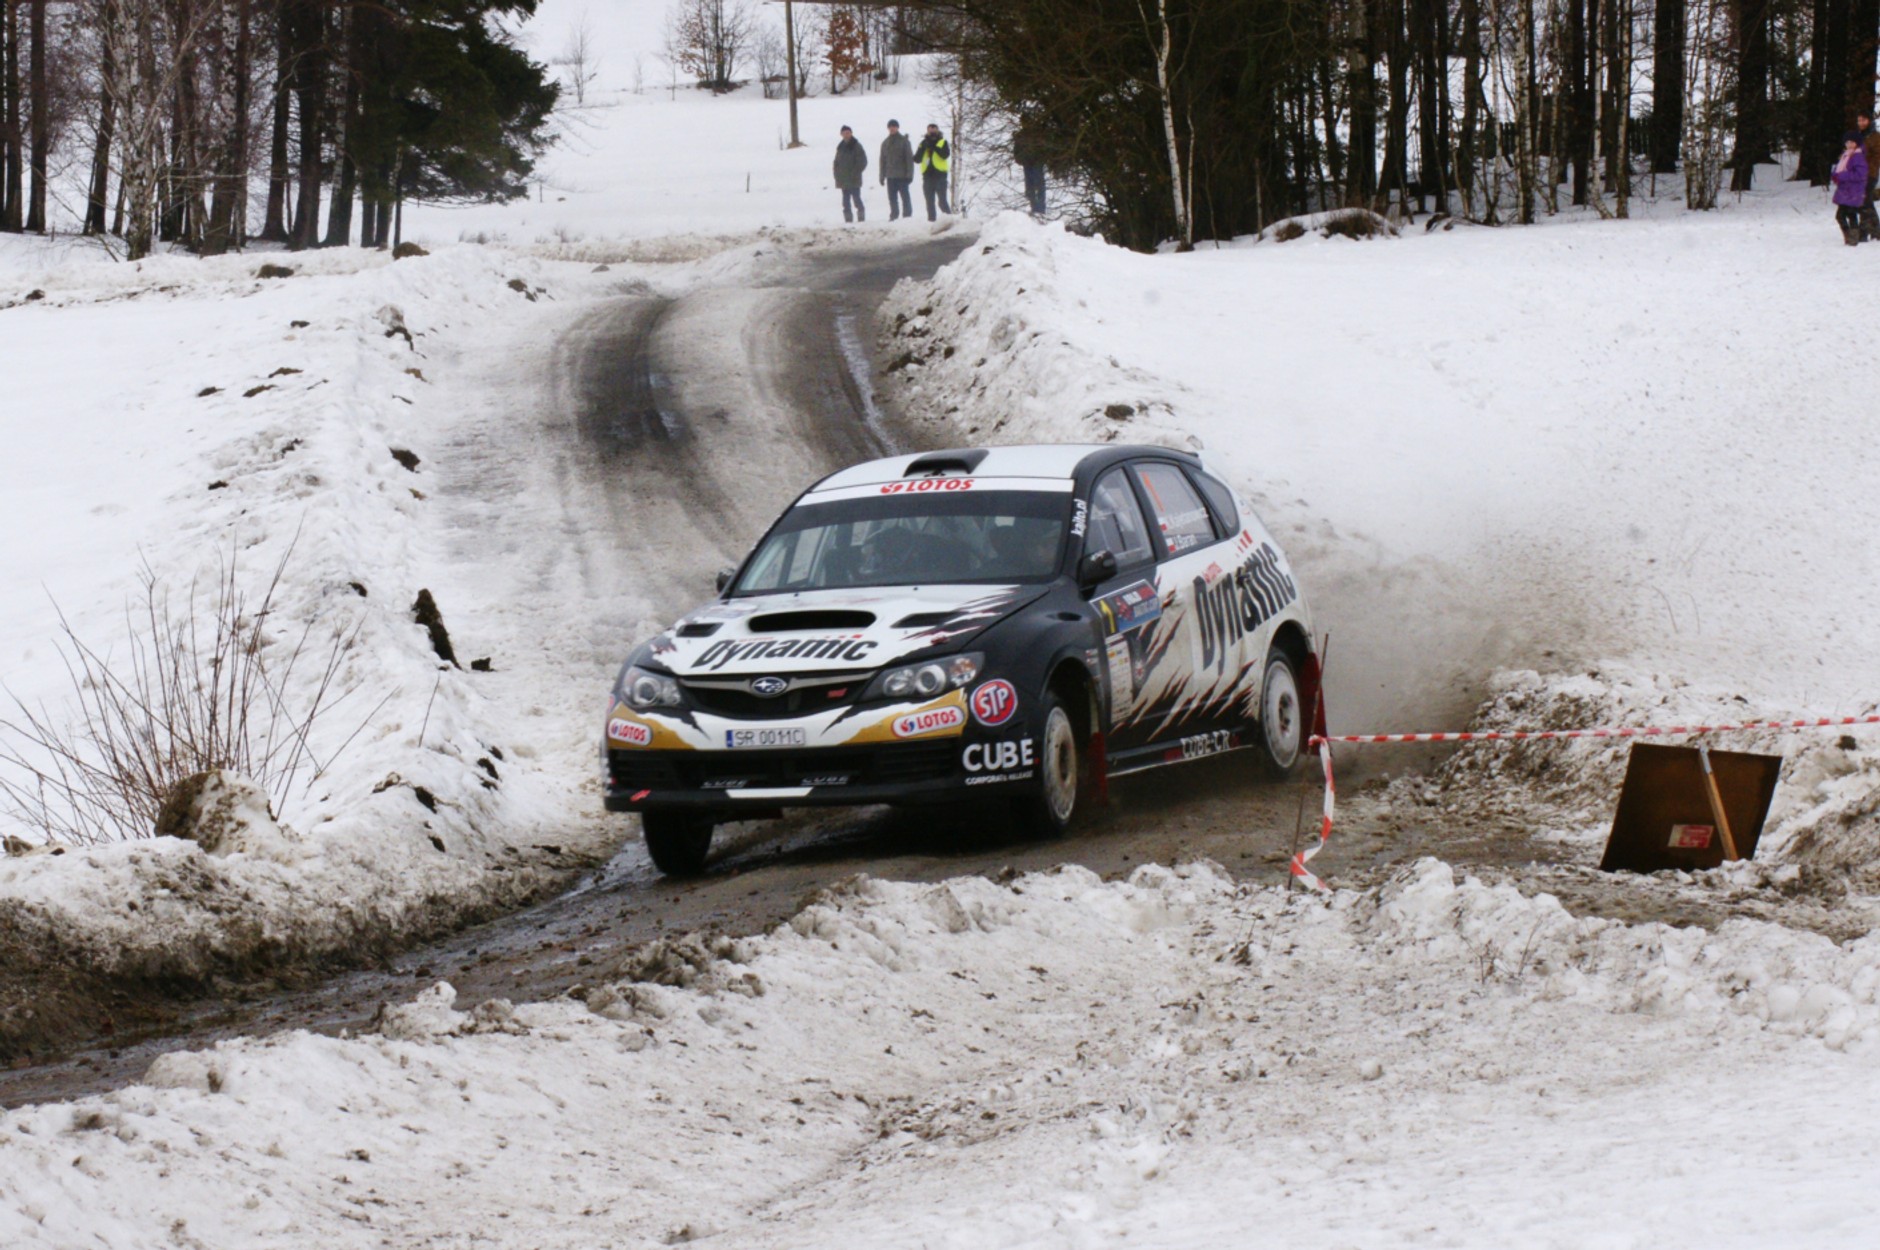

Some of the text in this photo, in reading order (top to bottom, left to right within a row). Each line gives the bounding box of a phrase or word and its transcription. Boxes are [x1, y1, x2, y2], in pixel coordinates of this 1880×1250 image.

[906, 479, 974, 492] LOTOS
[1193, 541, 1296, 678] Dynamic
[691, 638, 878, 671] Dynamic
[978, 685, 1010, 719] STP
[916, 709, 957, 729] LOTOS
[618, 723, 646, 742] LOTOS
[735, 730, 755, 746] SR
